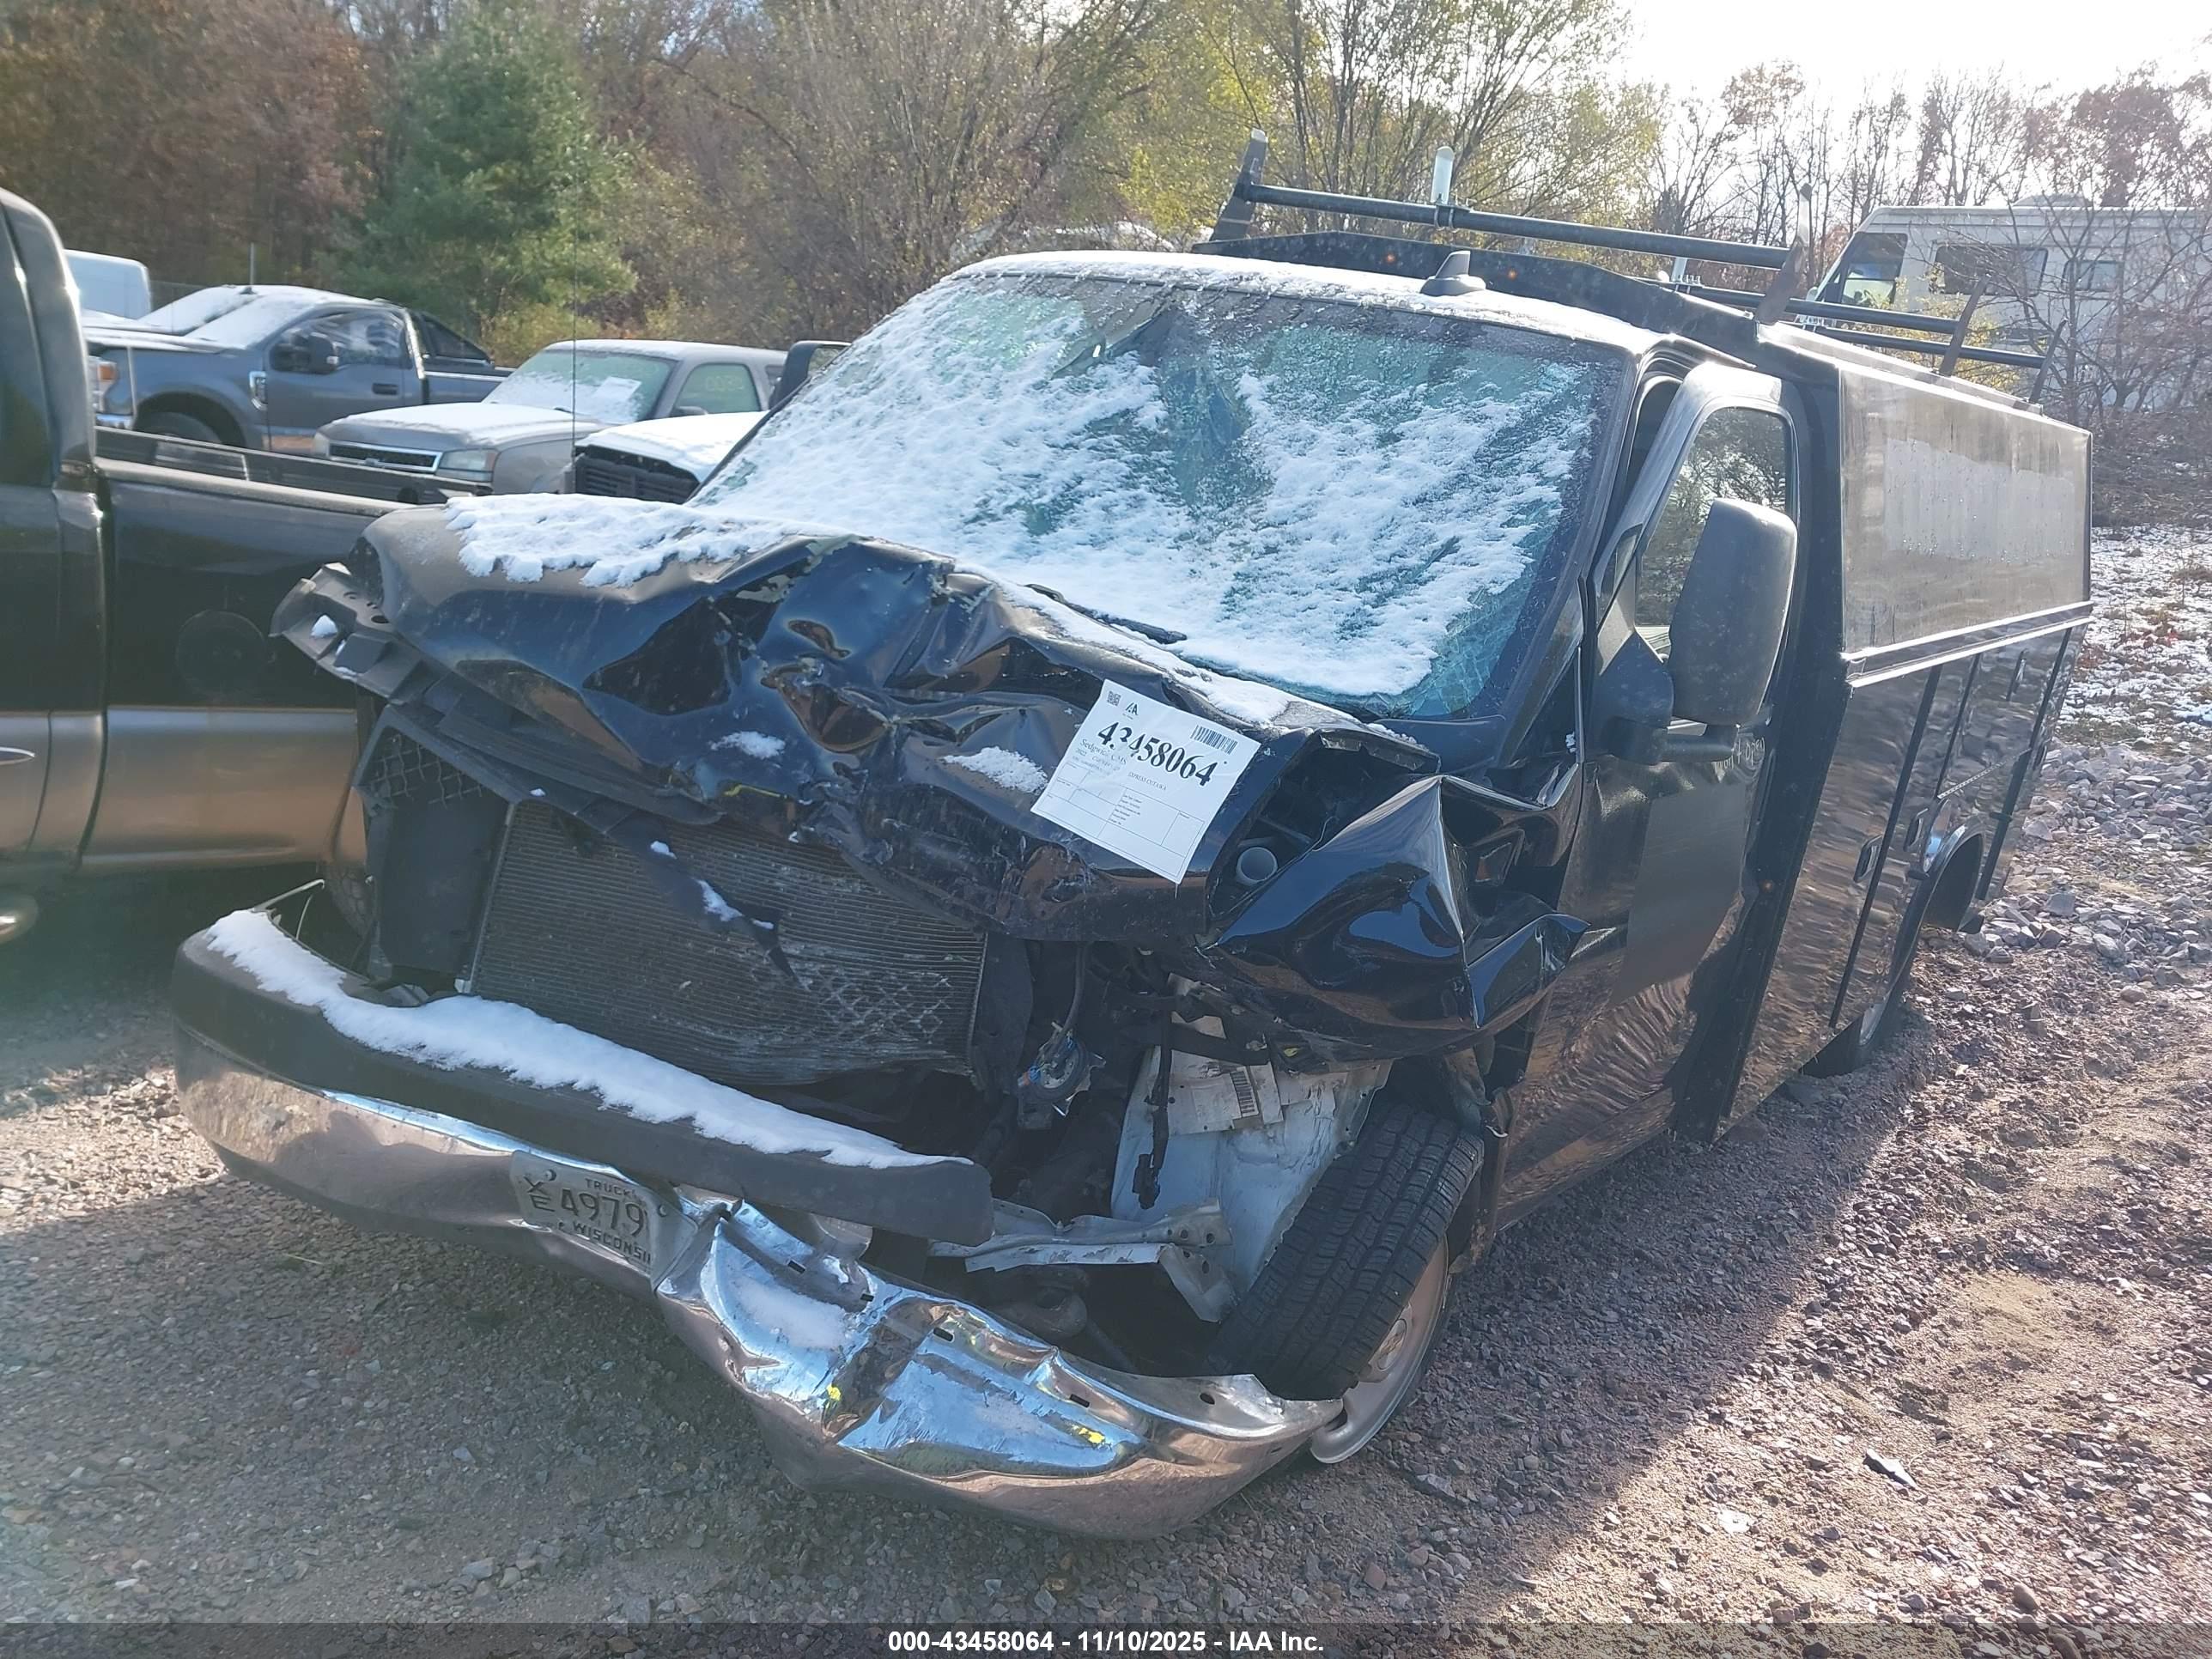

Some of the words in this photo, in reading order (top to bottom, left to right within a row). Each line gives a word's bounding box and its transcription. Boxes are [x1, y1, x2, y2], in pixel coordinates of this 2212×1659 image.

[1097, 721, 1218, 787] 43458064
[1745, 737, 1765, 767] open
[562, 1188, 646, 1238] 4979
